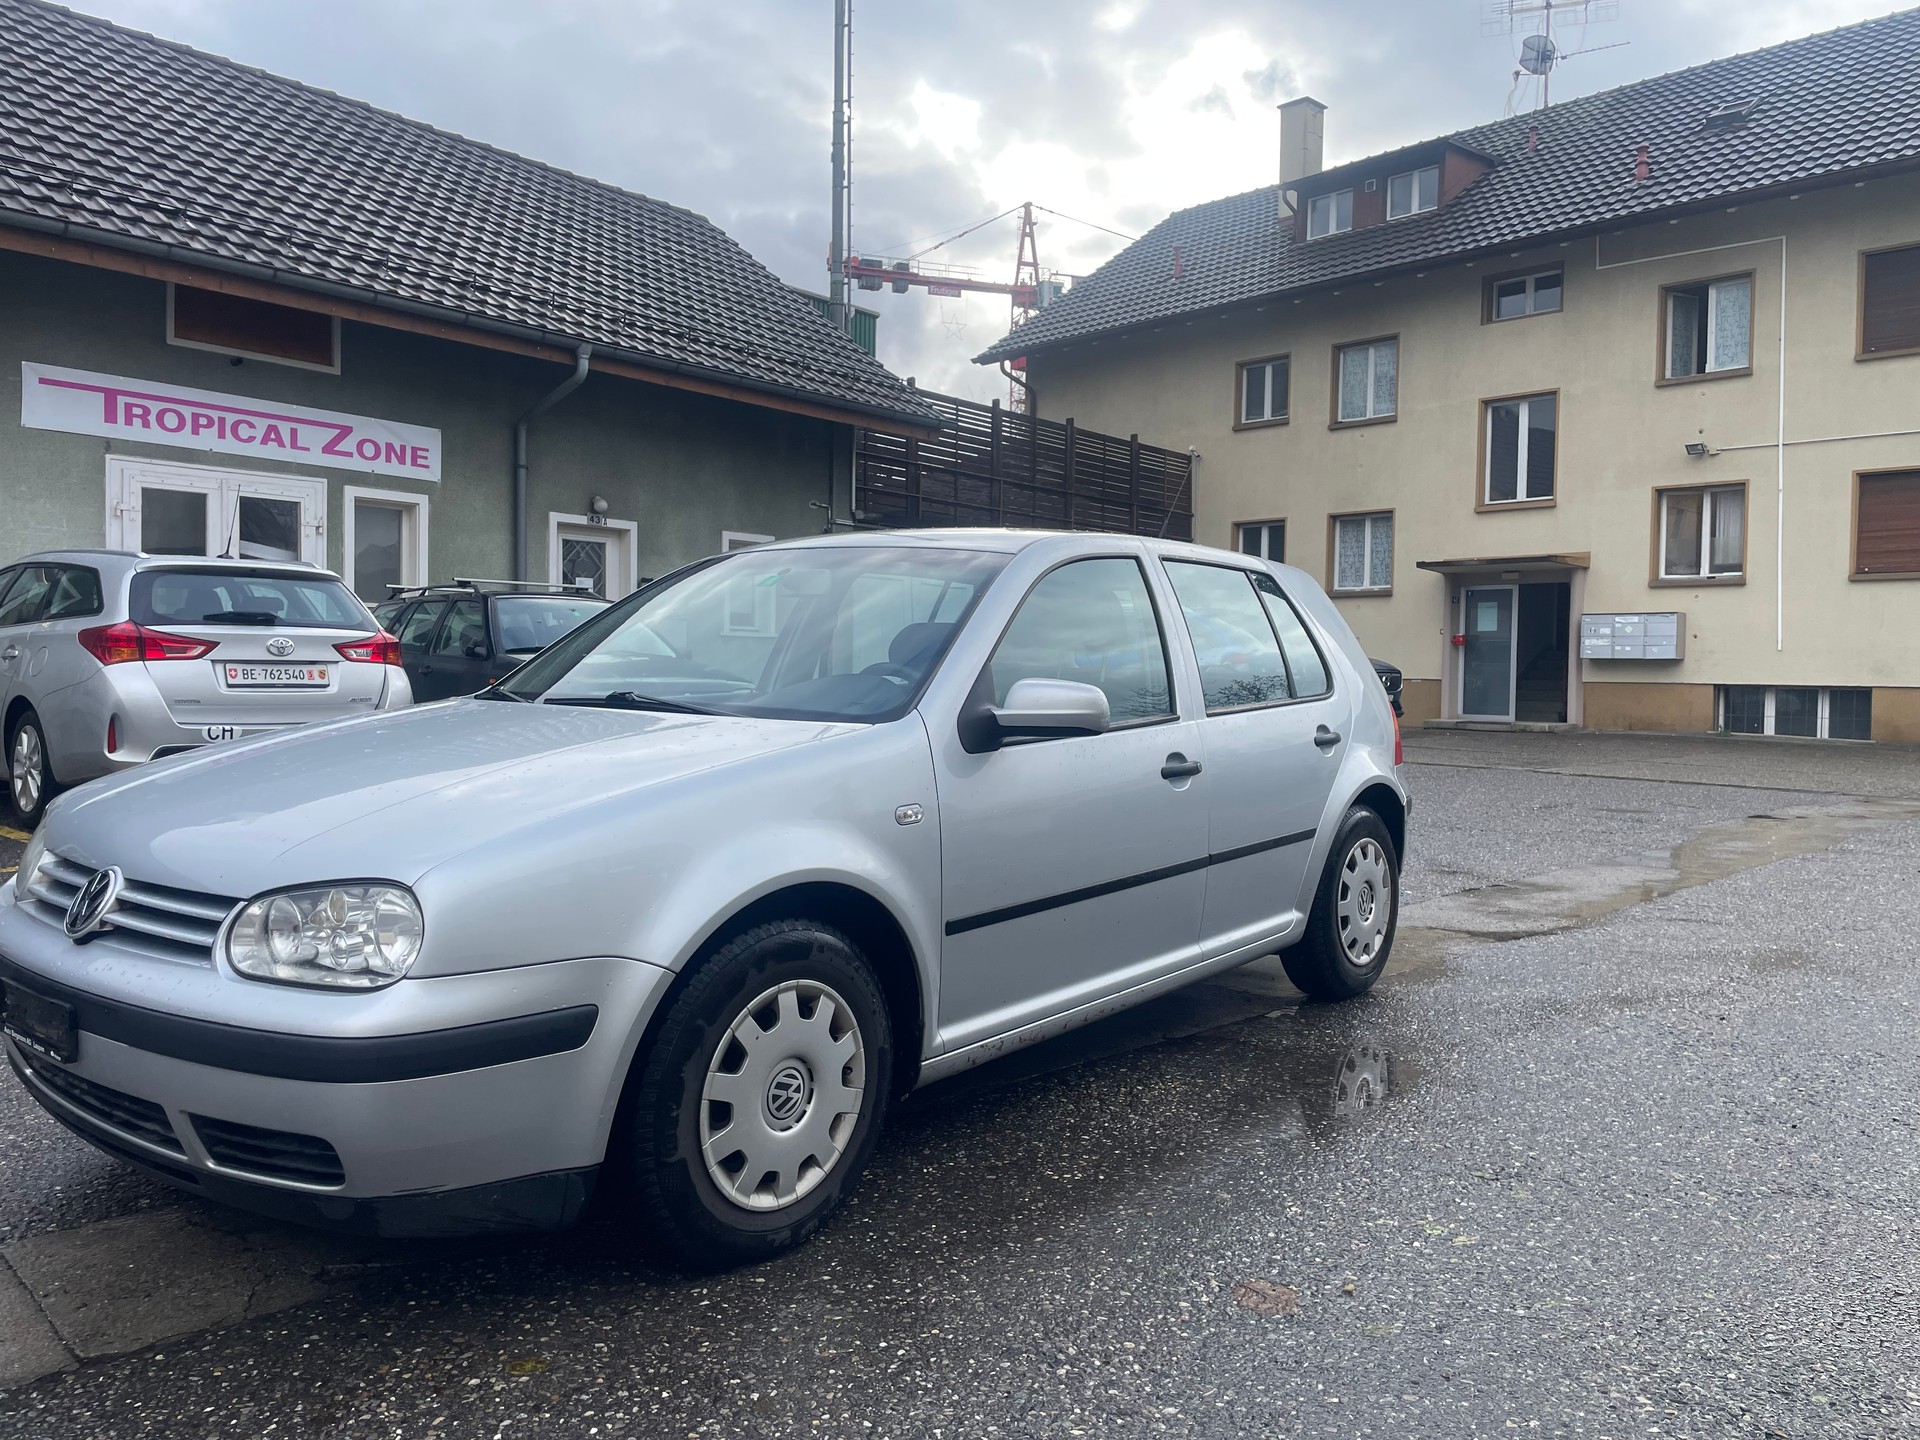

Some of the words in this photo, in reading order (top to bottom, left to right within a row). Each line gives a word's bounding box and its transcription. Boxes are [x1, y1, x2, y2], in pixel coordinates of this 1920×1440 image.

[930, 285, 960, 297] Frutiger
[38, 376, 311, 452] TROPICAL
[321, 424, 431, 469] ZONE
[589, 516, 600, 525] 43
[207, 726, 234, 740] CH
